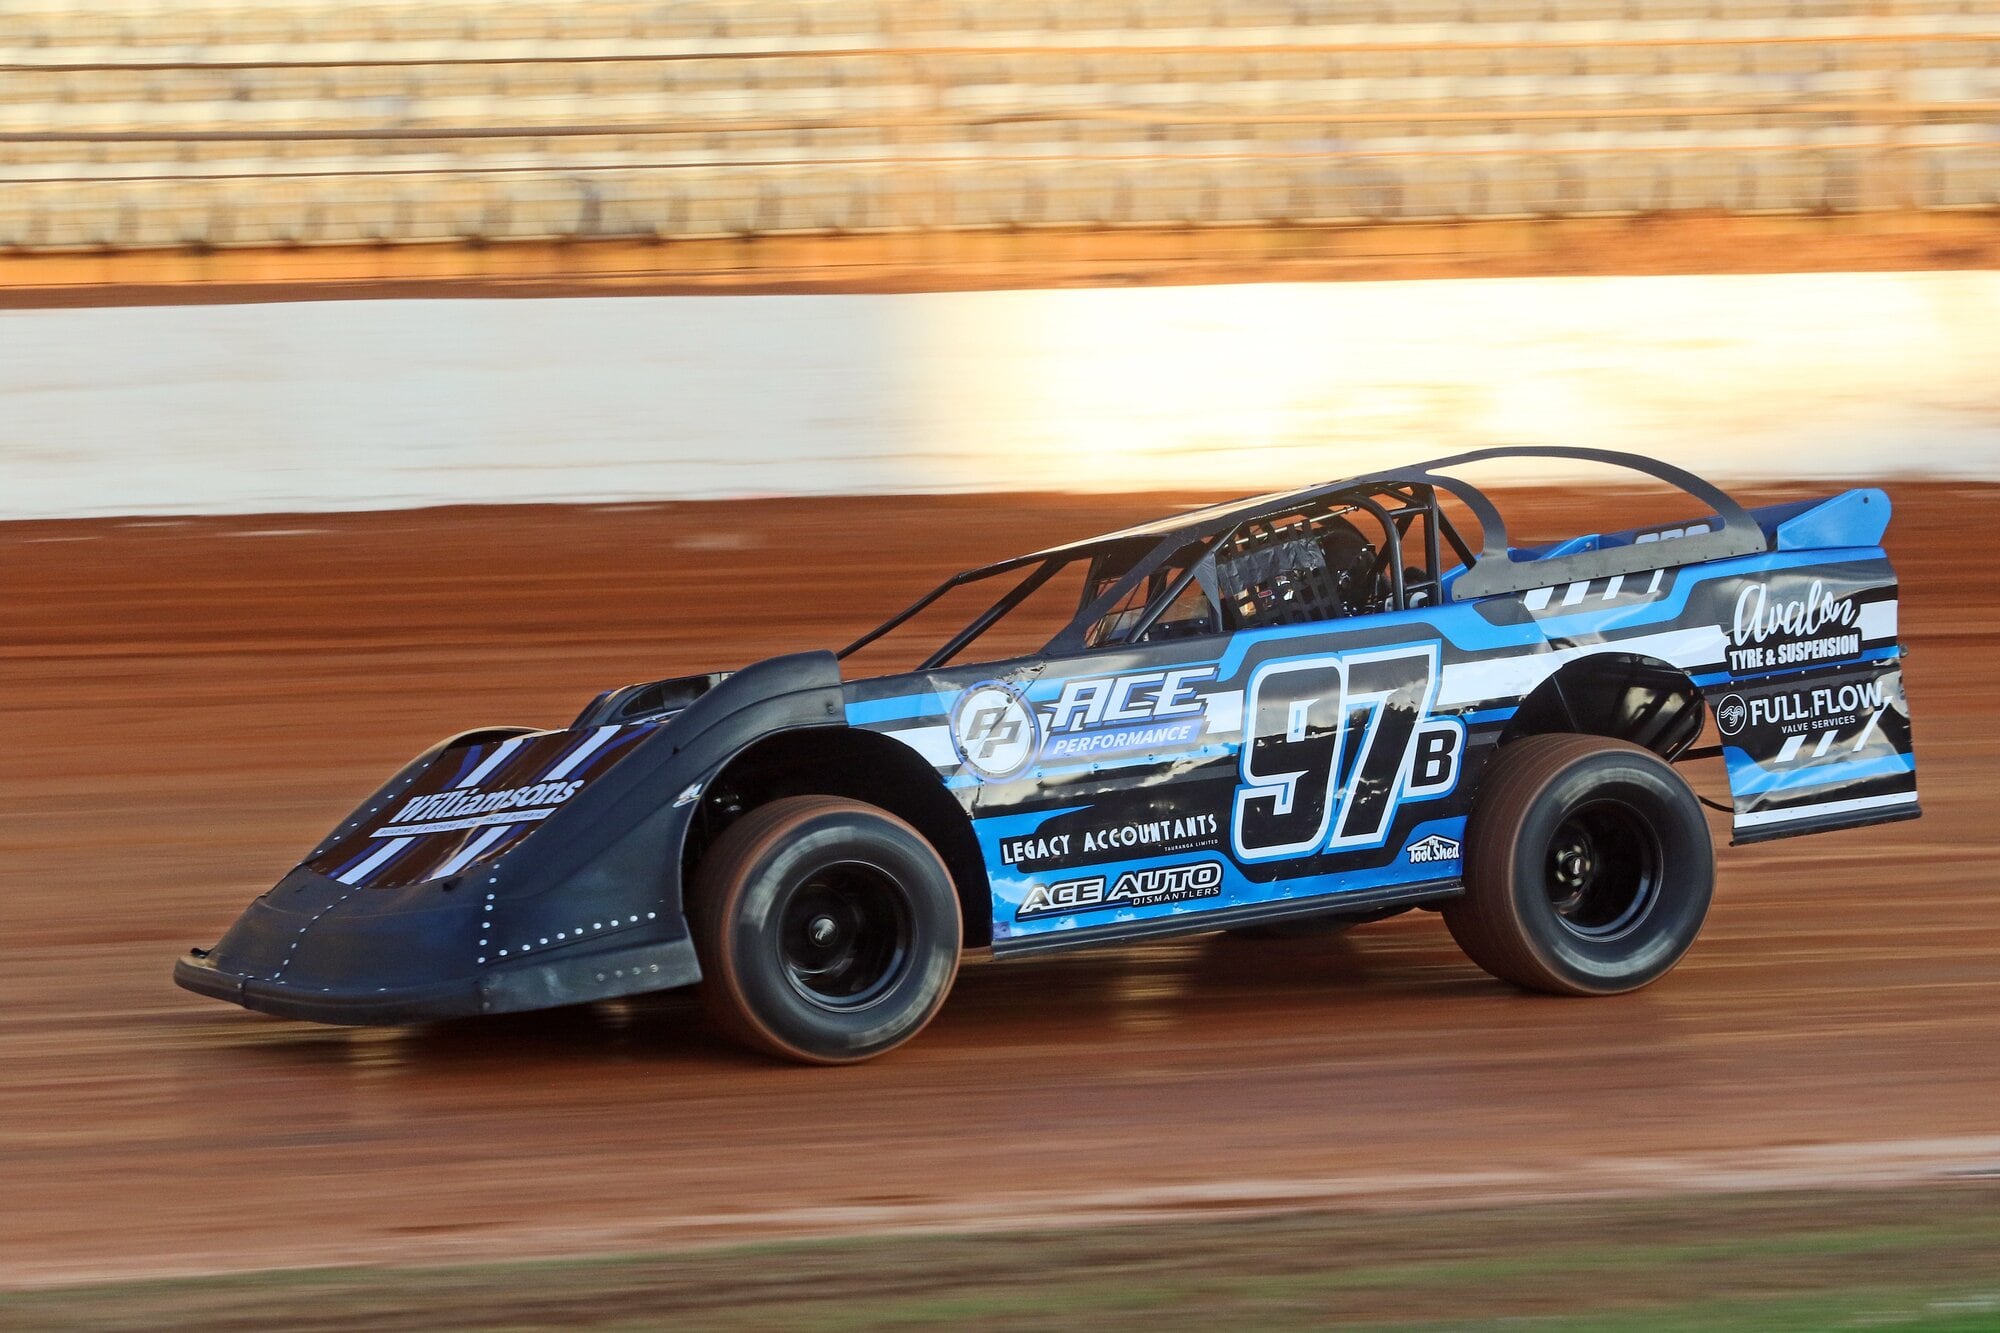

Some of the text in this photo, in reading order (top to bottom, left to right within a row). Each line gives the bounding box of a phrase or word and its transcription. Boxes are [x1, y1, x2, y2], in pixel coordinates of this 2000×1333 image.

[1733, 580, 1856, 646] Avalon
[1729, 634, 1859, 671] TYRE & SUSPENSION
[1042, 667, 1215, 731] ACE
[1750, 681, 1883, 726] FULL FLOW
[1053, 725, 1192, 754] PERFORMANCE
[1782, 715, 1856, 734] VALVE SERVICES
[388, 780, 585, 823] Williamsons
[1002, 813, 1218, 864] LEGACY ACCOUNTANTS
[1164, 839, 1219, 852] TAURANGA LIMITED
[1407, 843, 1460, 863] Tool Shed
[1018, 863, 1222, 914] ACE AUTO
[1133, 886, 1220, 906] DISMANTLERS
